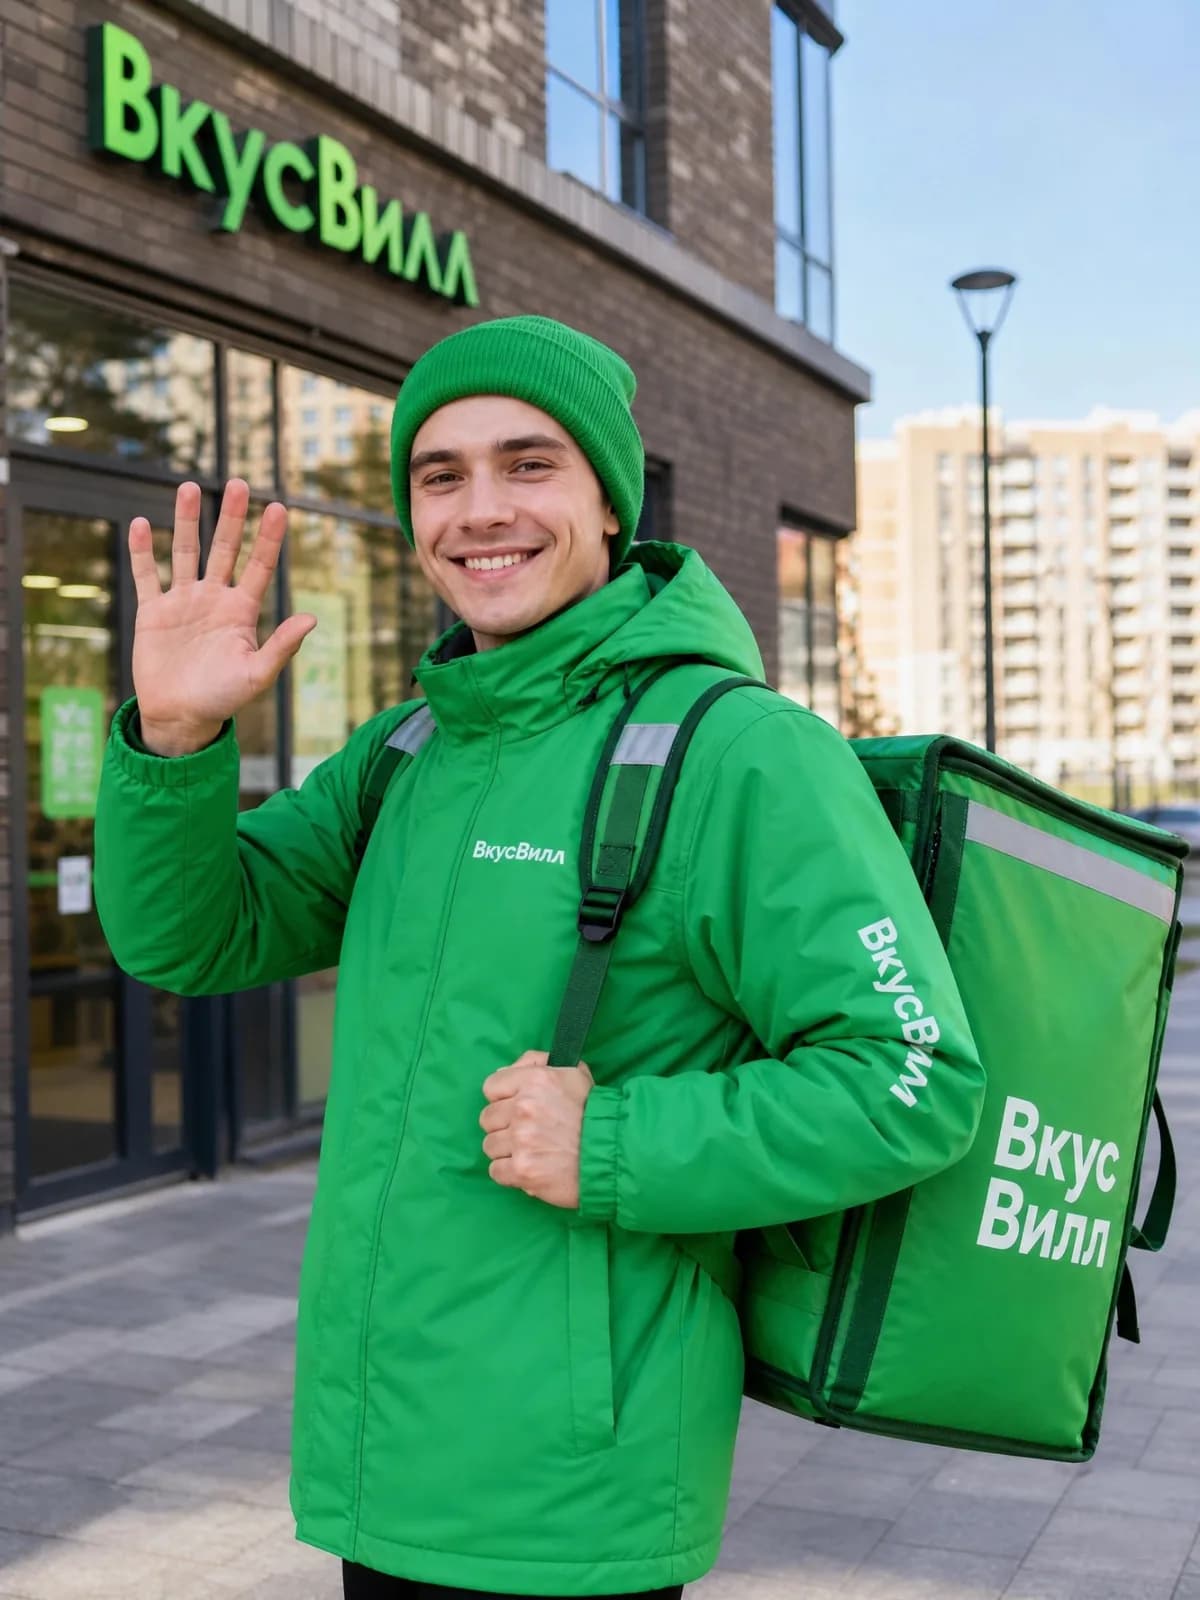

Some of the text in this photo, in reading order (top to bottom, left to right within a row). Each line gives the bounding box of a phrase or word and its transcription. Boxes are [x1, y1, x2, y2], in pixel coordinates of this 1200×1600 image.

[102, 21, 480, 308] ВкусВилл
[472, 840, 565, 865] ВкусВилл
[994, 1095, 1120, 1204] Вкус
[976, 1176, 1111, 1268] Вилл
